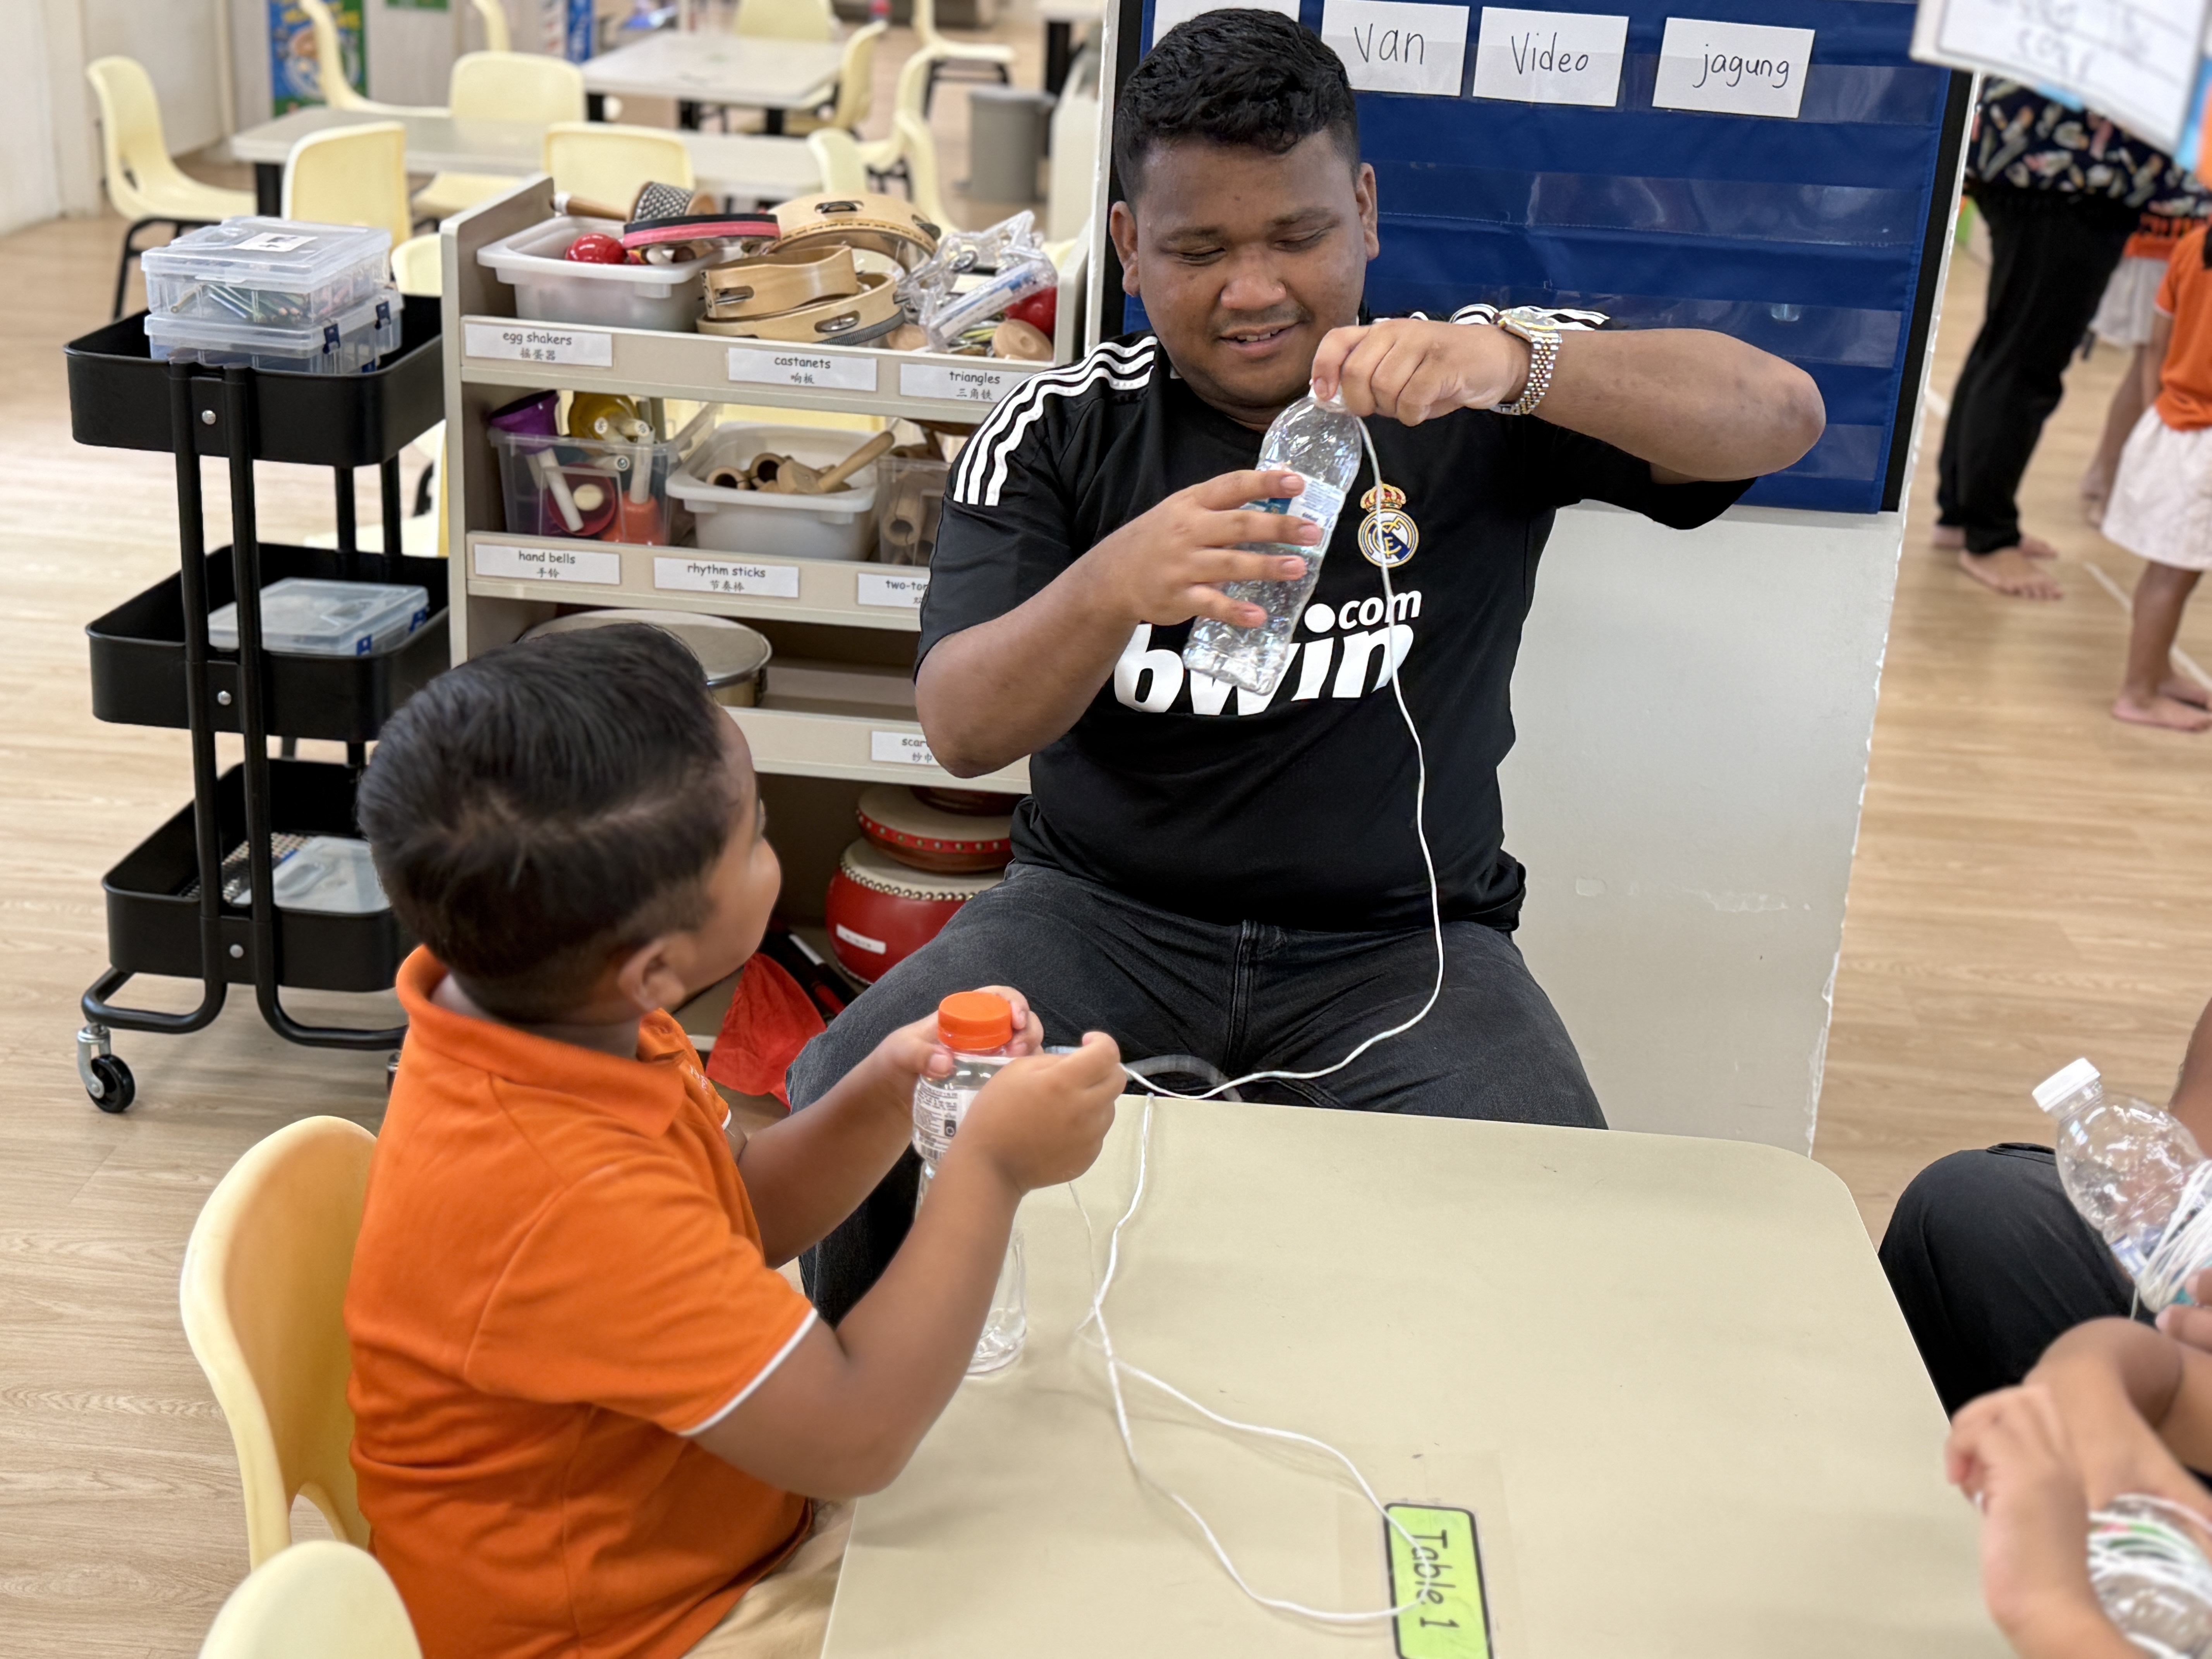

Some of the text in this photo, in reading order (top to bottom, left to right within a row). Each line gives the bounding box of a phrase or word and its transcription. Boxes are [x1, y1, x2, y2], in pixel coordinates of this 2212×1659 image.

[1354, 23, 1424, 65] Van
[1511, 32, 1589, 75] Video
[1692, 43, 1790, 89] jagung
[503, 332, 572, 346] egg shakers
[775, 356, 831, 369] castanets
[790, 372, 814, 385] 响板
[949, 371, 1001, 386] triangles
[956, 388, 993, 400] 三角铁
[519, 550, 576, 564] hand bells
[536, 567, 560, 579] 手铃
[687, 562, 766, 578] rhythm sticks
[709, 580, 745, 592] 节奏棒
[1114, 623, 1414, 716] bwin
[1411, 1528, 1461, 1628] Table 1
